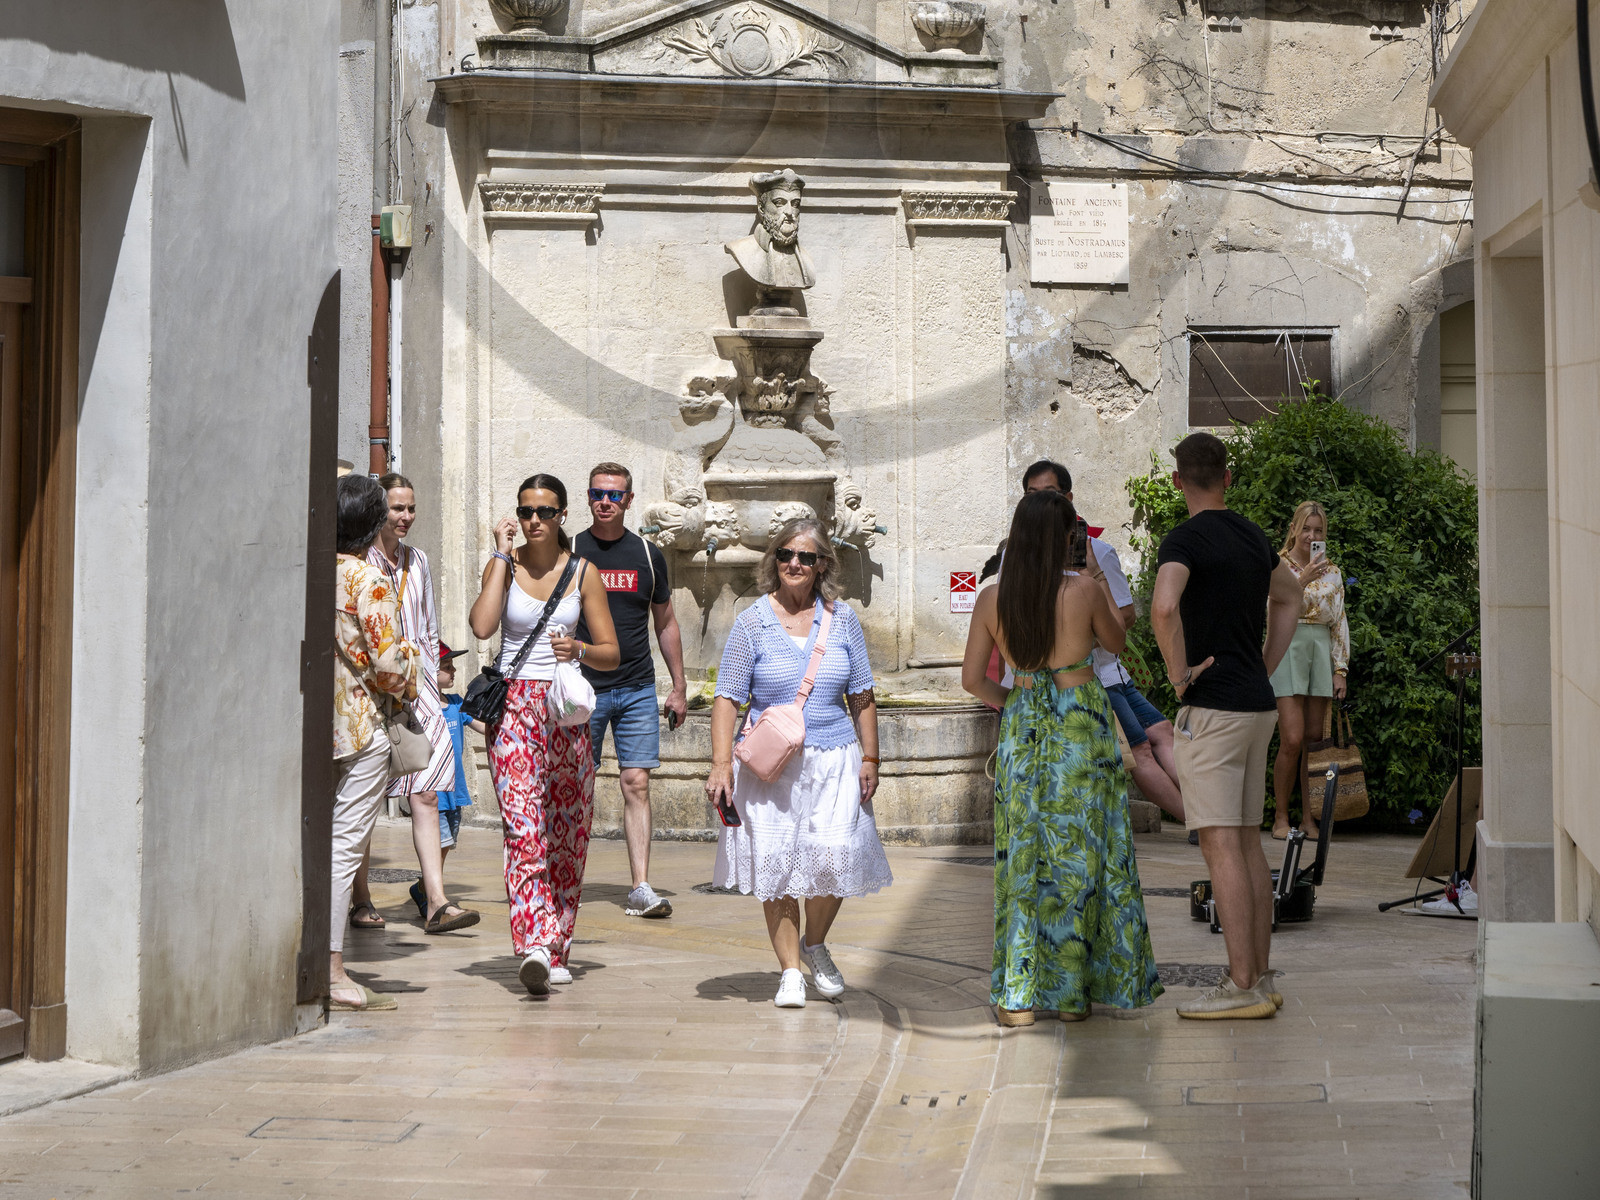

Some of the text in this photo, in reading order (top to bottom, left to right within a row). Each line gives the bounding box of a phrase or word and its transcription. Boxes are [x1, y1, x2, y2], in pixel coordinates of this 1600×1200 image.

[1038, 196, 1122, 207] FONTAINE ANCIENNE
[1035, 238, 1054, 246] BUSTE
[1068, 236, 1126, 247] NOSTRADAMUS
[1094, 250, 1124, 259] LAMBESC
